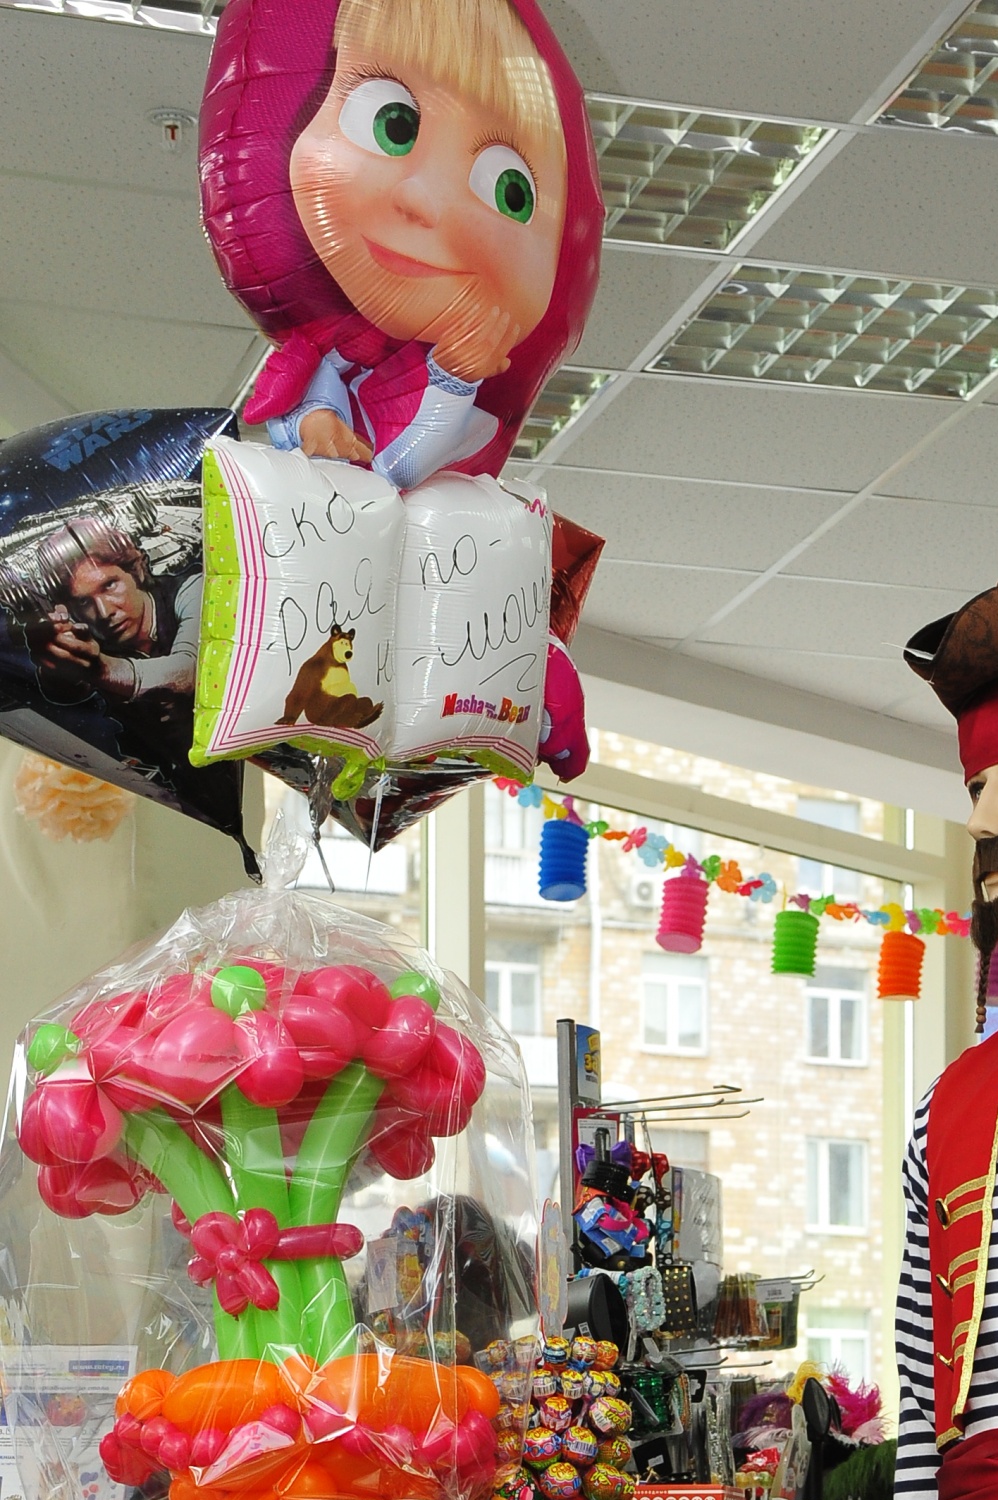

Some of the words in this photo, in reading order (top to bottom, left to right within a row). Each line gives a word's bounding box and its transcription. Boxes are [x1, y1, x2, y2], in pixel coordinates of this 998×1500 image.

[46, 411, 152, 472] WARS
[418, 534, 502, 590] по-
[442, 693, 485, 717] Masha
[498, 697, 531, 723] Bear
